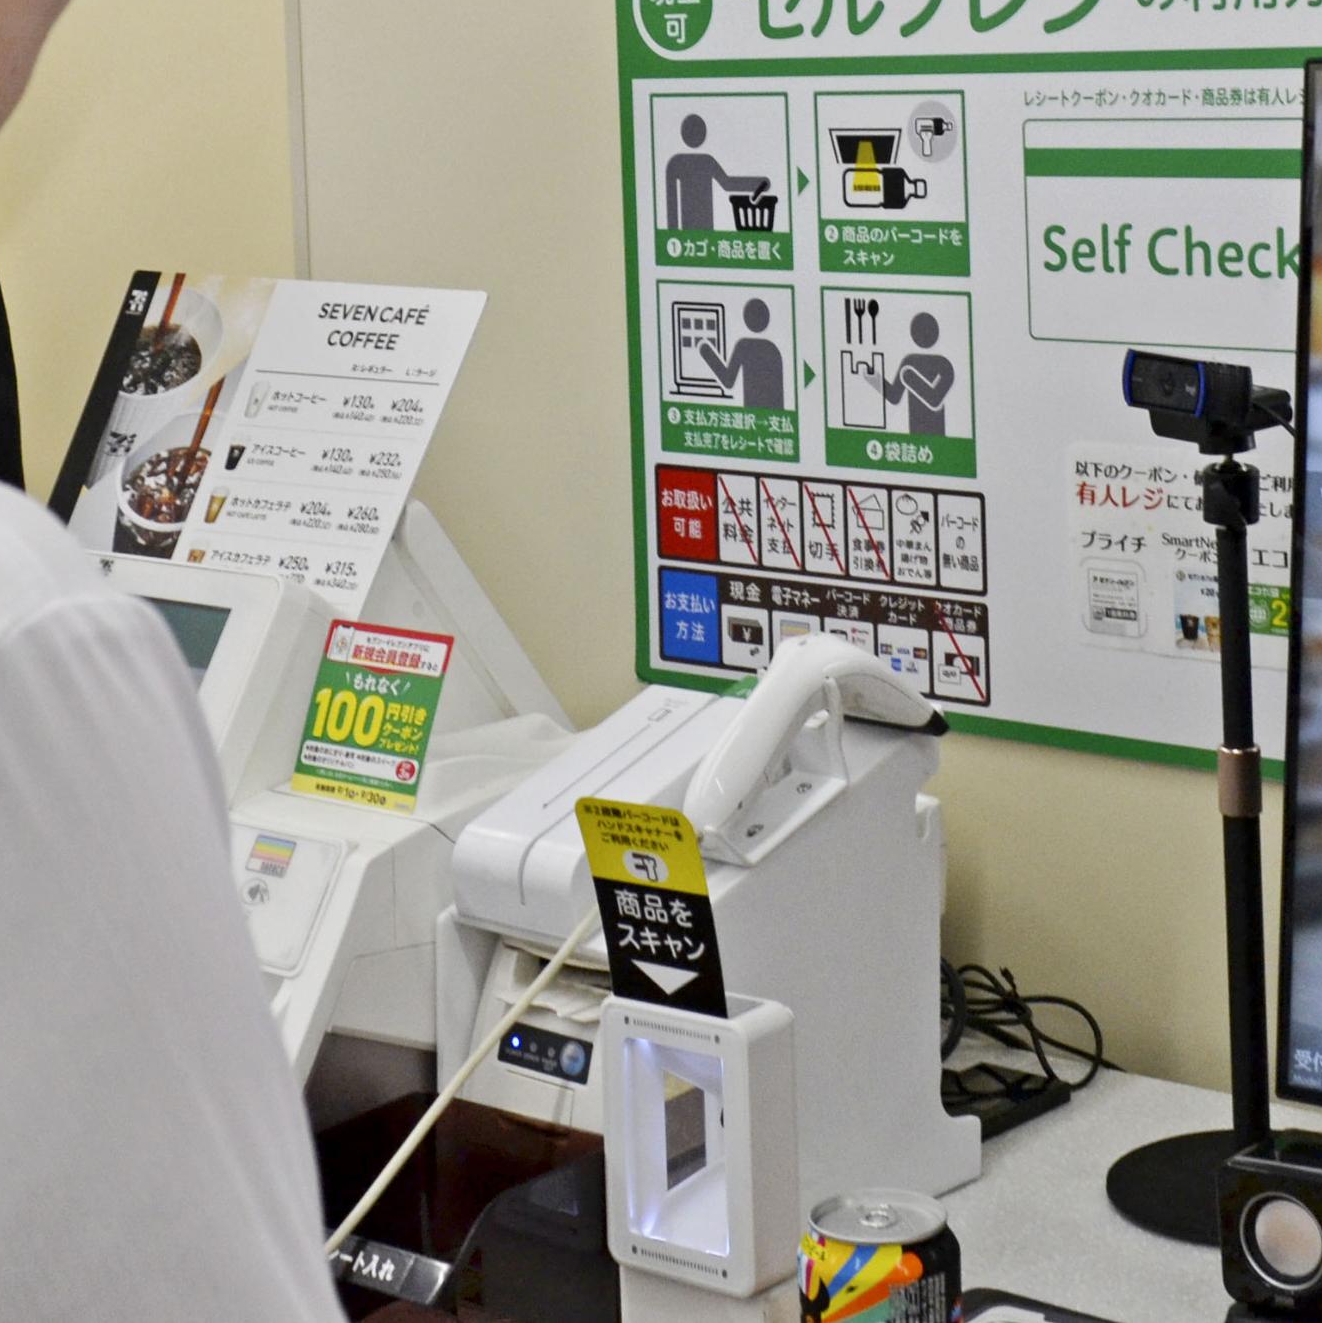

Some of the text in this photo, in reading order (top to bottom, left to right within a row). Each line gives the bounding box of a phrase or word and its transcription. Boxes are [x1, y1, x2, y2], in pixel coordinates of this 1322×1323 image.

[663, 12, 690, 43] 可
[844, 249, 894, 266] スキャン
[1044, 224, 1133, 275] Self
[318, 302, 378, 321] SEVEN
[327, 330, 400, 351] COFFEE
[884, 442, 933, 463] 袋詰め
[941, 515, 979, 531] バーコード
[956, 536, 965, 549] の
[664, 590, 716, 614] お支払い
[729, 580, 761, 603] 現金
[826, 589, 870, 605] バーコード
[888, 612, 917, 625] カード
[676, 621, 705, 642] 方法
[354, 674, 400, 696] もれなく
[313, 688, 385, 746] 100
[383, 723, 423, 741] クーポン
[614, 888, 693, 928] 商品を
[617, 923, 705, 960] スキャン
